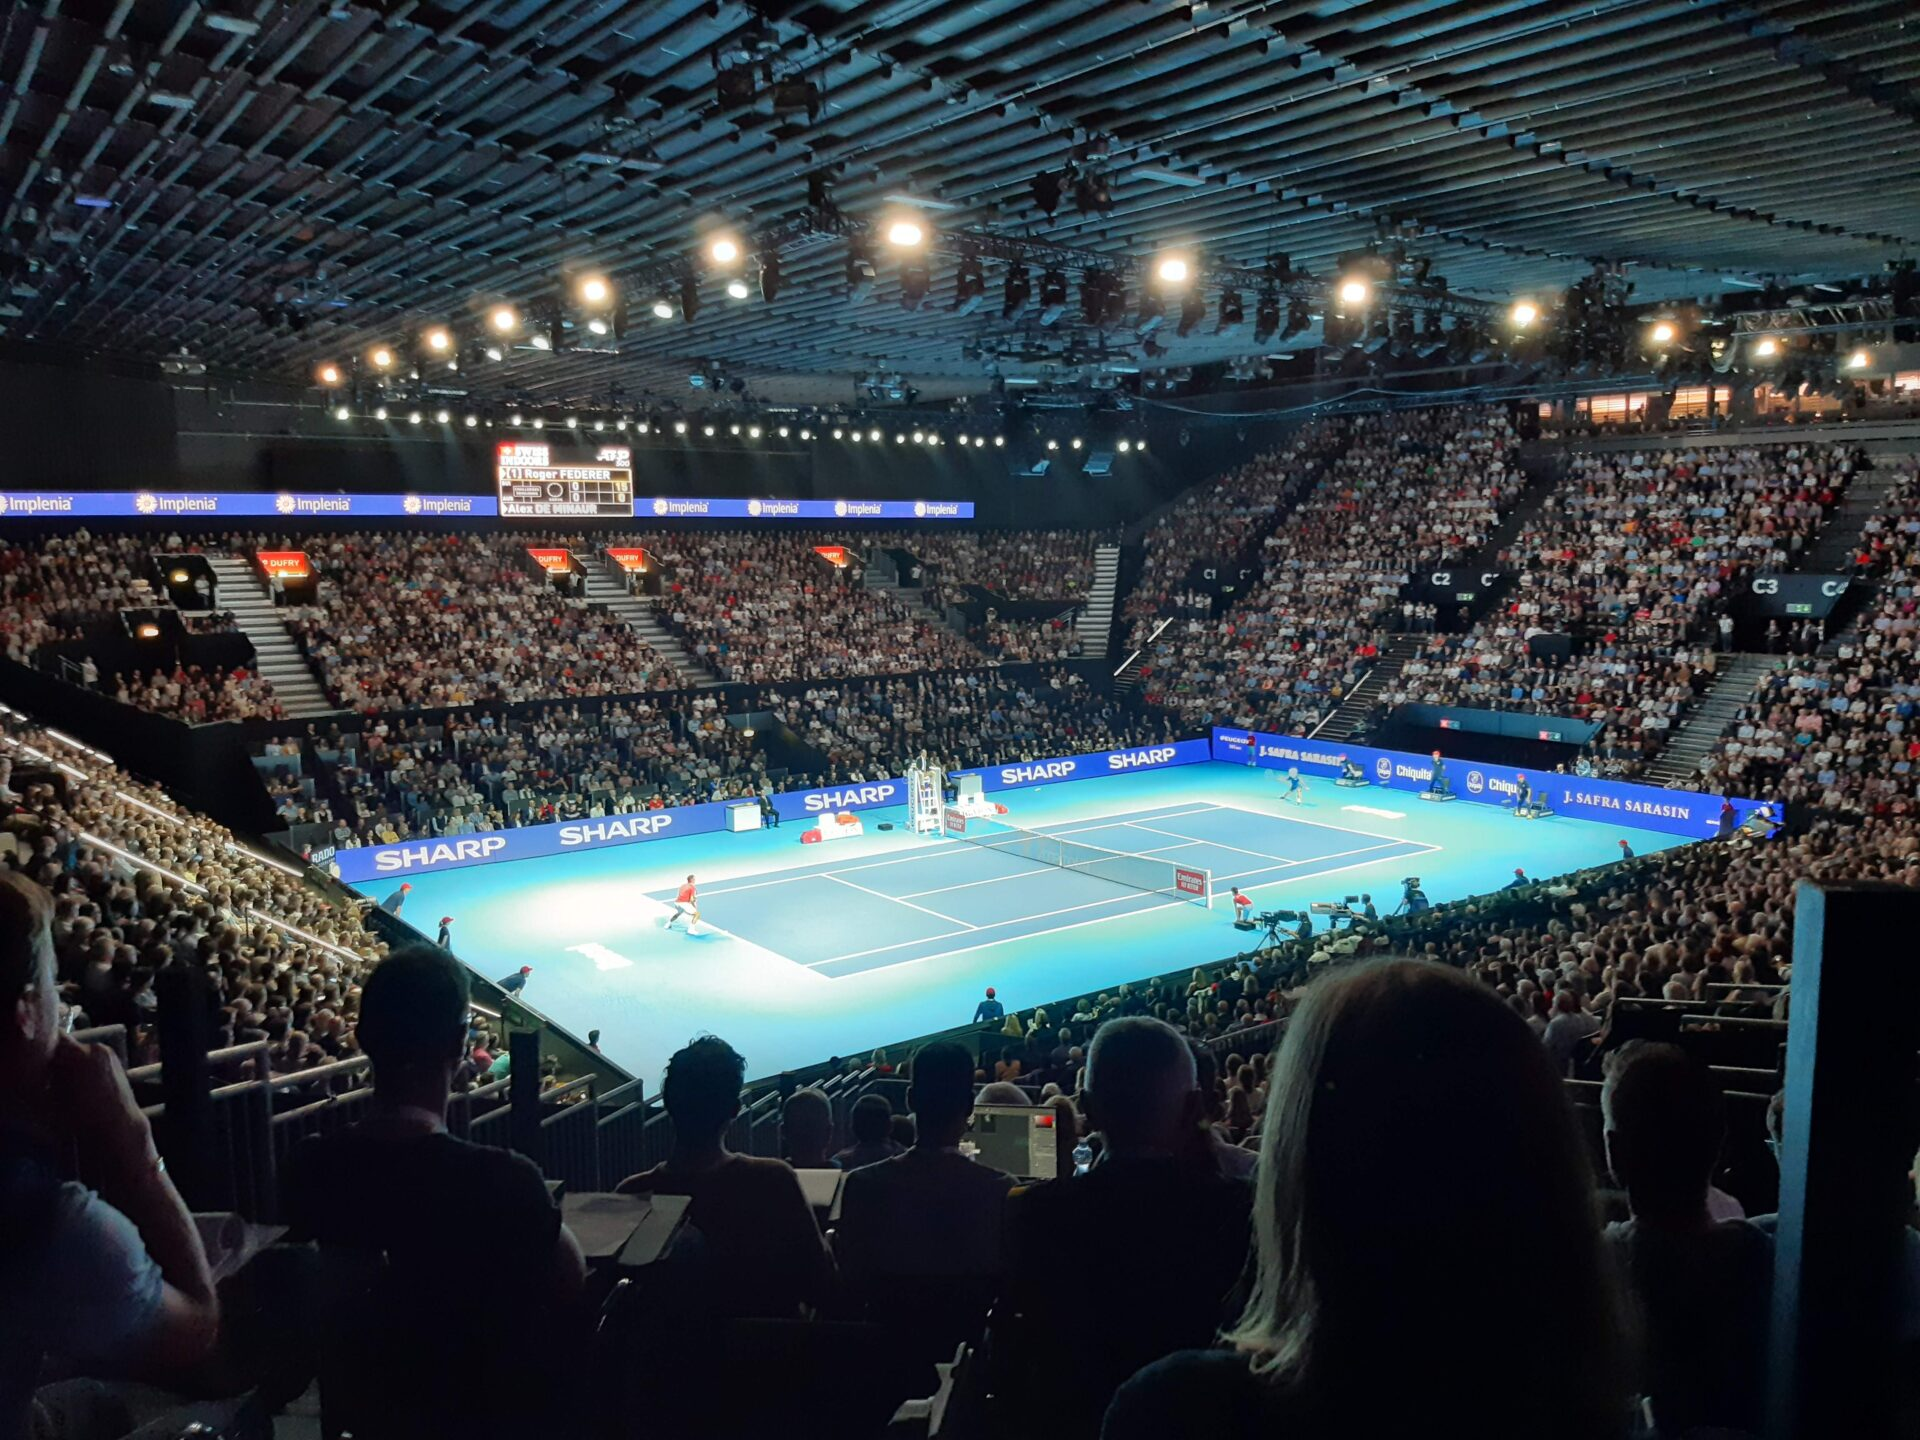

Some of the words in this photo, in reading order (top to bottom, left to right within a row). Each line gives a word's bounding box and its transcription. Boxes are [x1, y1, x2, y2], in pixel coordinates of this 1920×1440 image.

[525, 469, 558, 481] Roger
[560, 470, 611, 480] FEDERER
[571, 481, 580, 491] 0
[615, 482, 628, 492] 15
[572, 492, 580, 502] 0
[618, 492, 626, 503] 0
[9, 496, 73, 514] Implenia
[159, 497, 217, 514] Implenia
[297, 498, 351, 514] Implenia
[423, 499, 472, 514] Implenia
[508, 504, 533, 514] Alex
[535, 504, 551, 514] DE
[553, 504, 598, 514] MINAUR
[669, 501, 710, 515] Implenia
[762, 502, 799, 516] Implenia
[848, 503, 882, 516] Implenia
[270, 559, 300, 567] DUFRY
[1431, 572, 1451, 586] C2
[1752, 579, 1779, 594] C3
[1109, 748, 1176, 770] SHARP
[1259, 745, 1268, 757] J.
[1267, 746, 1299, 760] SAFRA
[1001, 761, 1076, 784] SHARP
[1396, 764, 1433, 782] Chiquita
[804, 784, 895, 811] SHARP
[1563, 791, 1573, 804] J.
[1576, 792, 1620, 810] SAFRA
[1624, 799, 1690, 820] SARASIN
[559, 814, 673, 845] SHARP
[311, 846, 335, 864] RADO
[375, 836, 506, 871] SHARP
